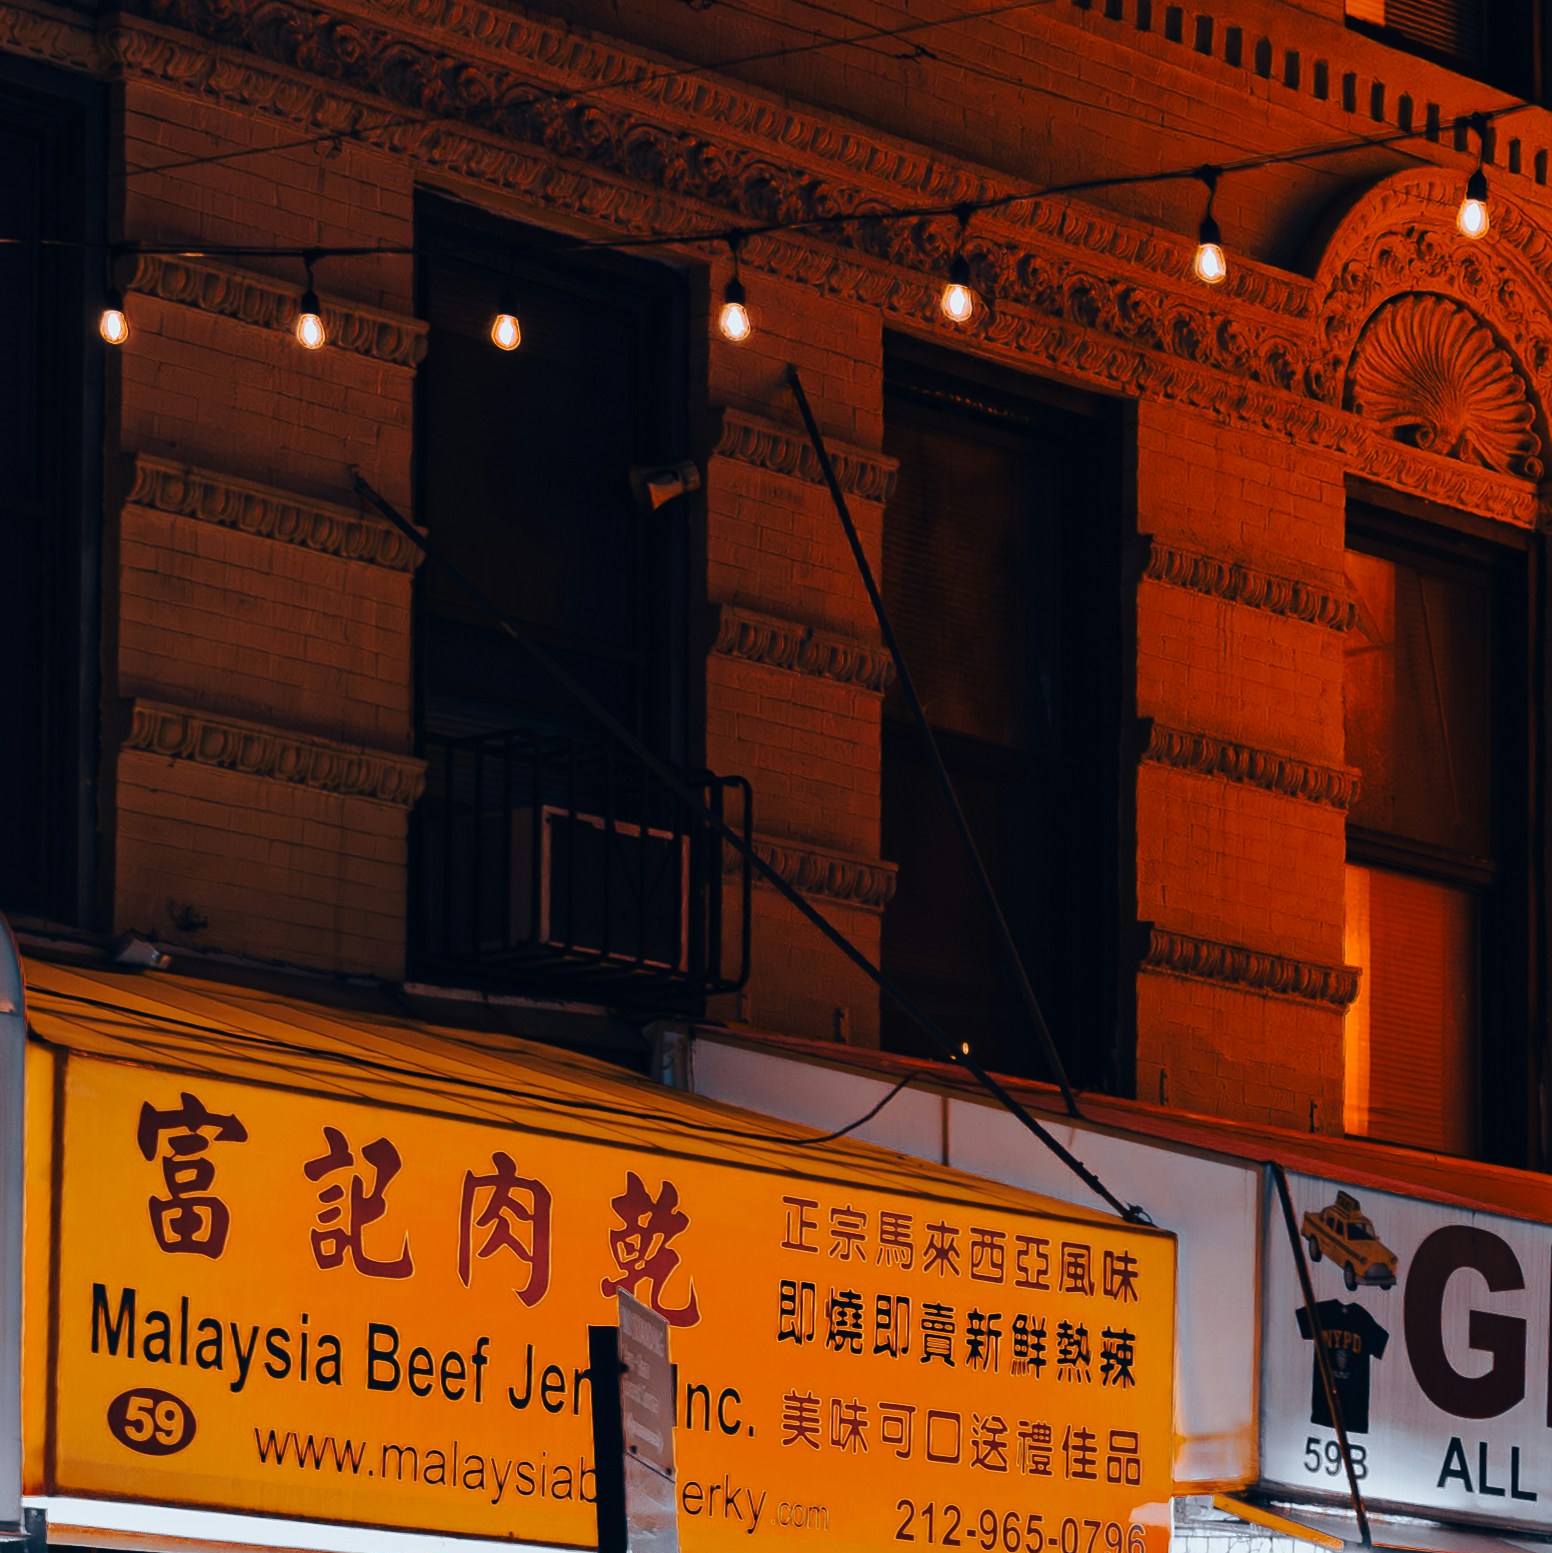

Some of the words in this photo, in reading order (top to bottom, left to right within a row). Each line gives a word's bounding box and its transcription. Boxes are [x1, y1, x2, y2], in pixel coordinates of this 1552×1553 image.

[780, 1194, 1140, 1304] 正宗馬來西亞風味
[90, 1283, 342, 1392] Malaysia
[366, 1322, 489, 1403] Beef
[508, 1342, 593, 1416] Jer
[669, 1363, 756, 1439] Inc.
[777, 1279, 1137, 1390] 即燒即賣新鮮熱辣
[124, 1396, 185, 1444] 59
[780, 1389, 1142, 1487] 美味可口送禮佳品
[1303, 1436, 1369, 1480] 59B
[1437, 1437, 1537, 1503] ALL
